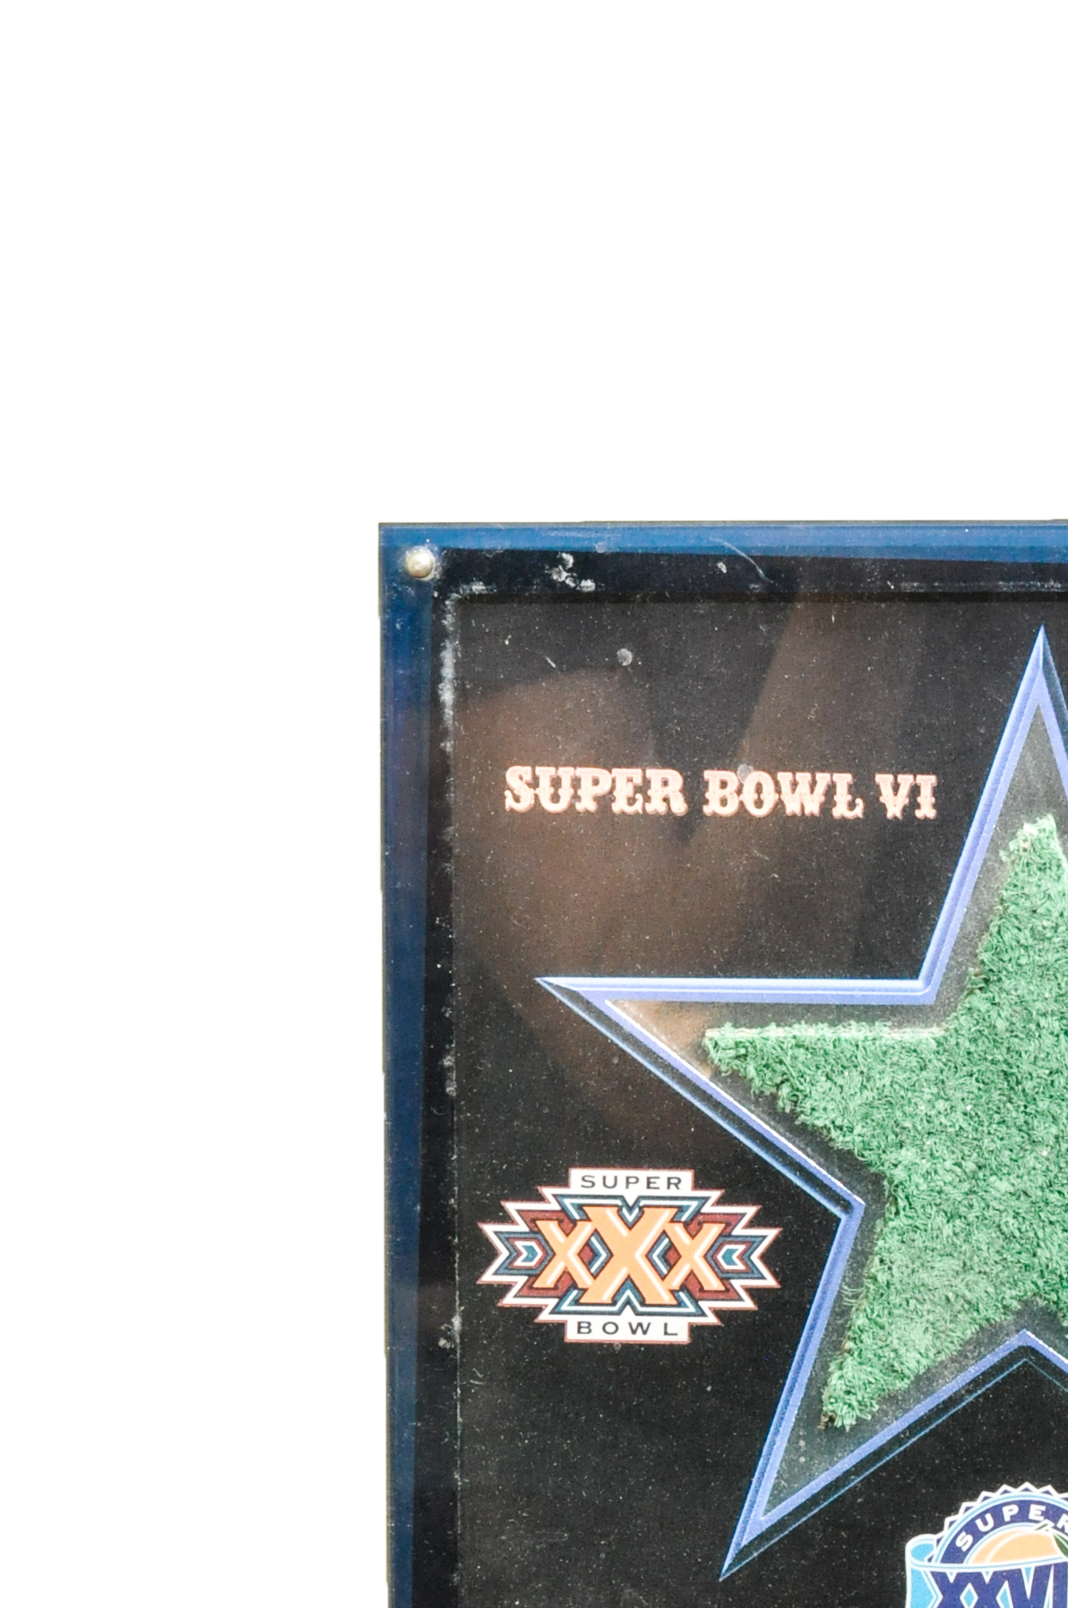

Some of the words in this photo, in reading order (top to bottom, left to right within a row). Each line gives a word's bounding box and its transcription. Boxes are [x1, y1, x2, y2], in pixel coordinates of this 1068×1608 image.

[505, 765, 688, 816] SUPER
[703, 769, 863, 819] BOWL
[875, 773, 937, 820] VI
[581, 1175, 682, 1190] SUPER
[533, 1206, 726, 1305] XXX
[577, 1321, 678, 1336] BOWL
